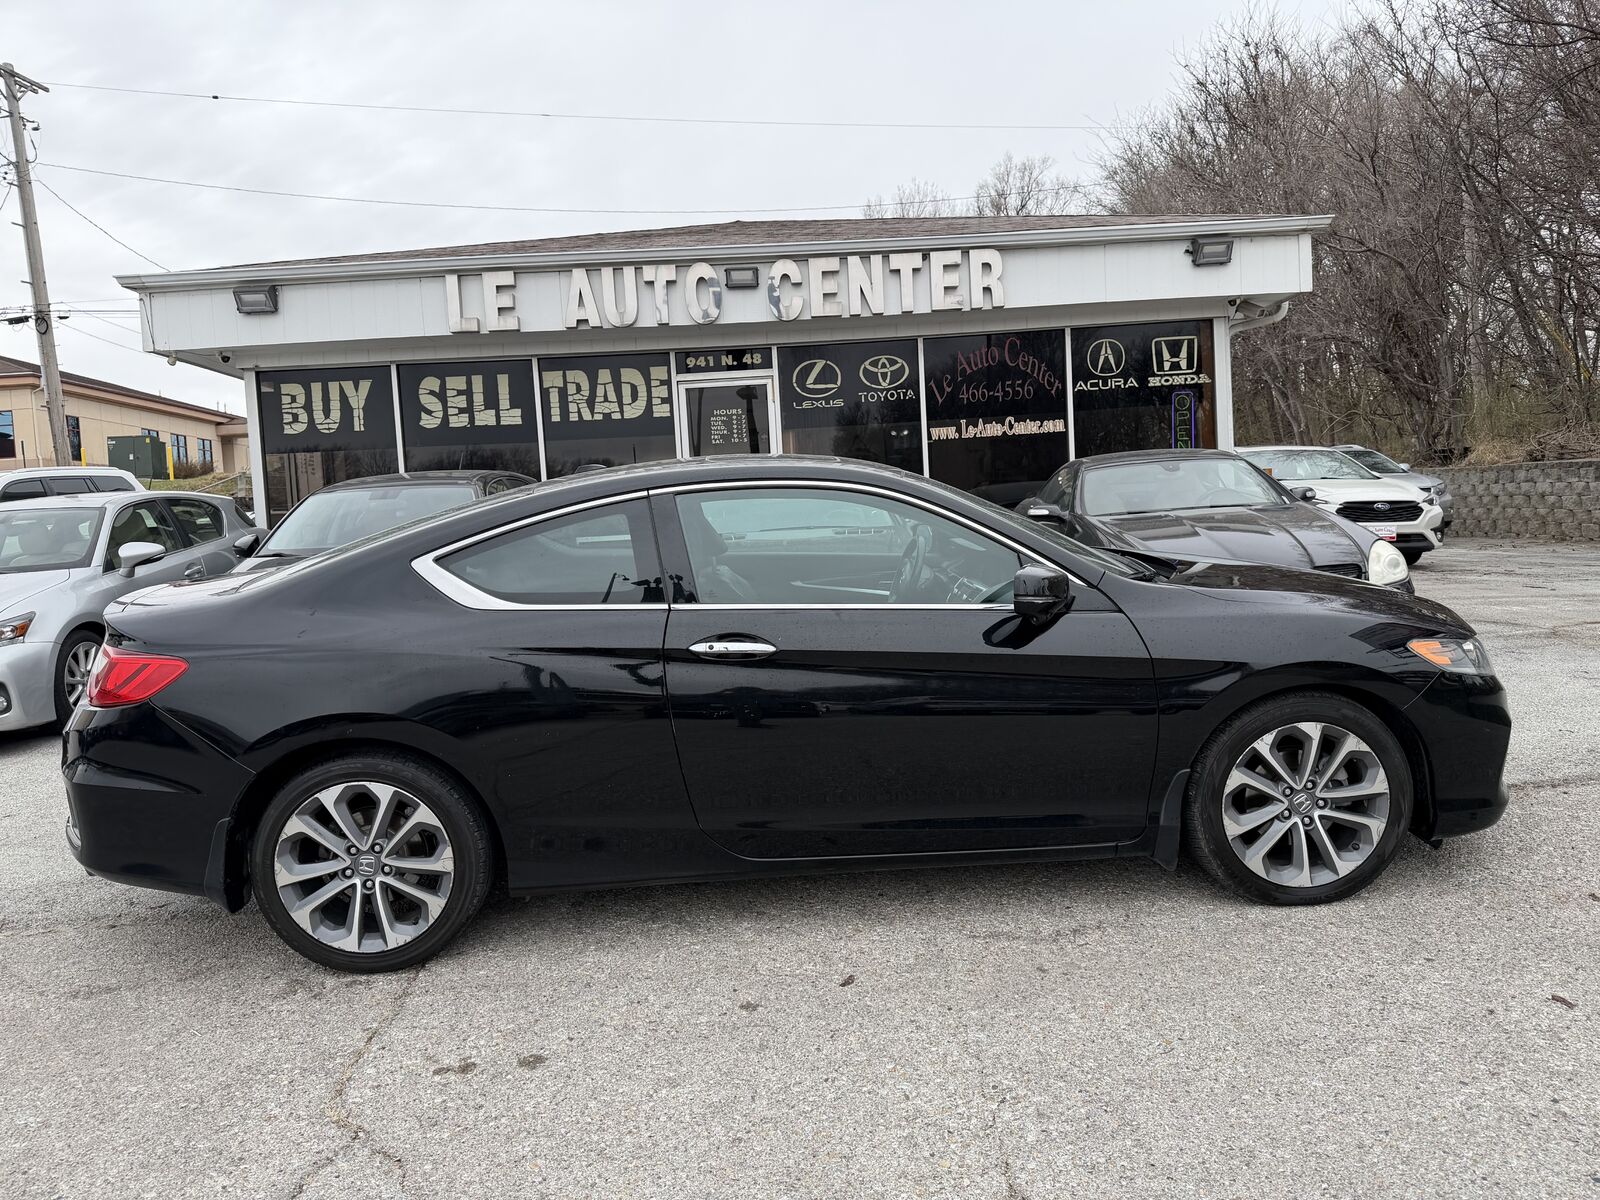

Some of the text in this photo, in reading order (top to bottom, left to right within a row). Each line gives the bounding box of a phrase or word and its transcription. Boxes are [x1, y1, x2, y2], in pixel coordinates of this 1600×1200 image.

[445, 249, 1005, 333] LE AUTO CENTER
[686, 352, 762, 368] 941 N. 48
[928, 337, 1062, 406] Le Auto Center
[1148, 373, 1212, 387] HONDA
[541, 366, 671, 422] TRADE
[959, 380, 1034, 404] 466-4556
[1074, 377, 1139, 391] ACURA
[418, 373, 522, 429] SELL
[793, 399, 844, 408] LEXUS
[858, 389, 916, 402] TOYOTA
[280, 379, 373, 435] BUY
[929, 426, 959, 440] www.
